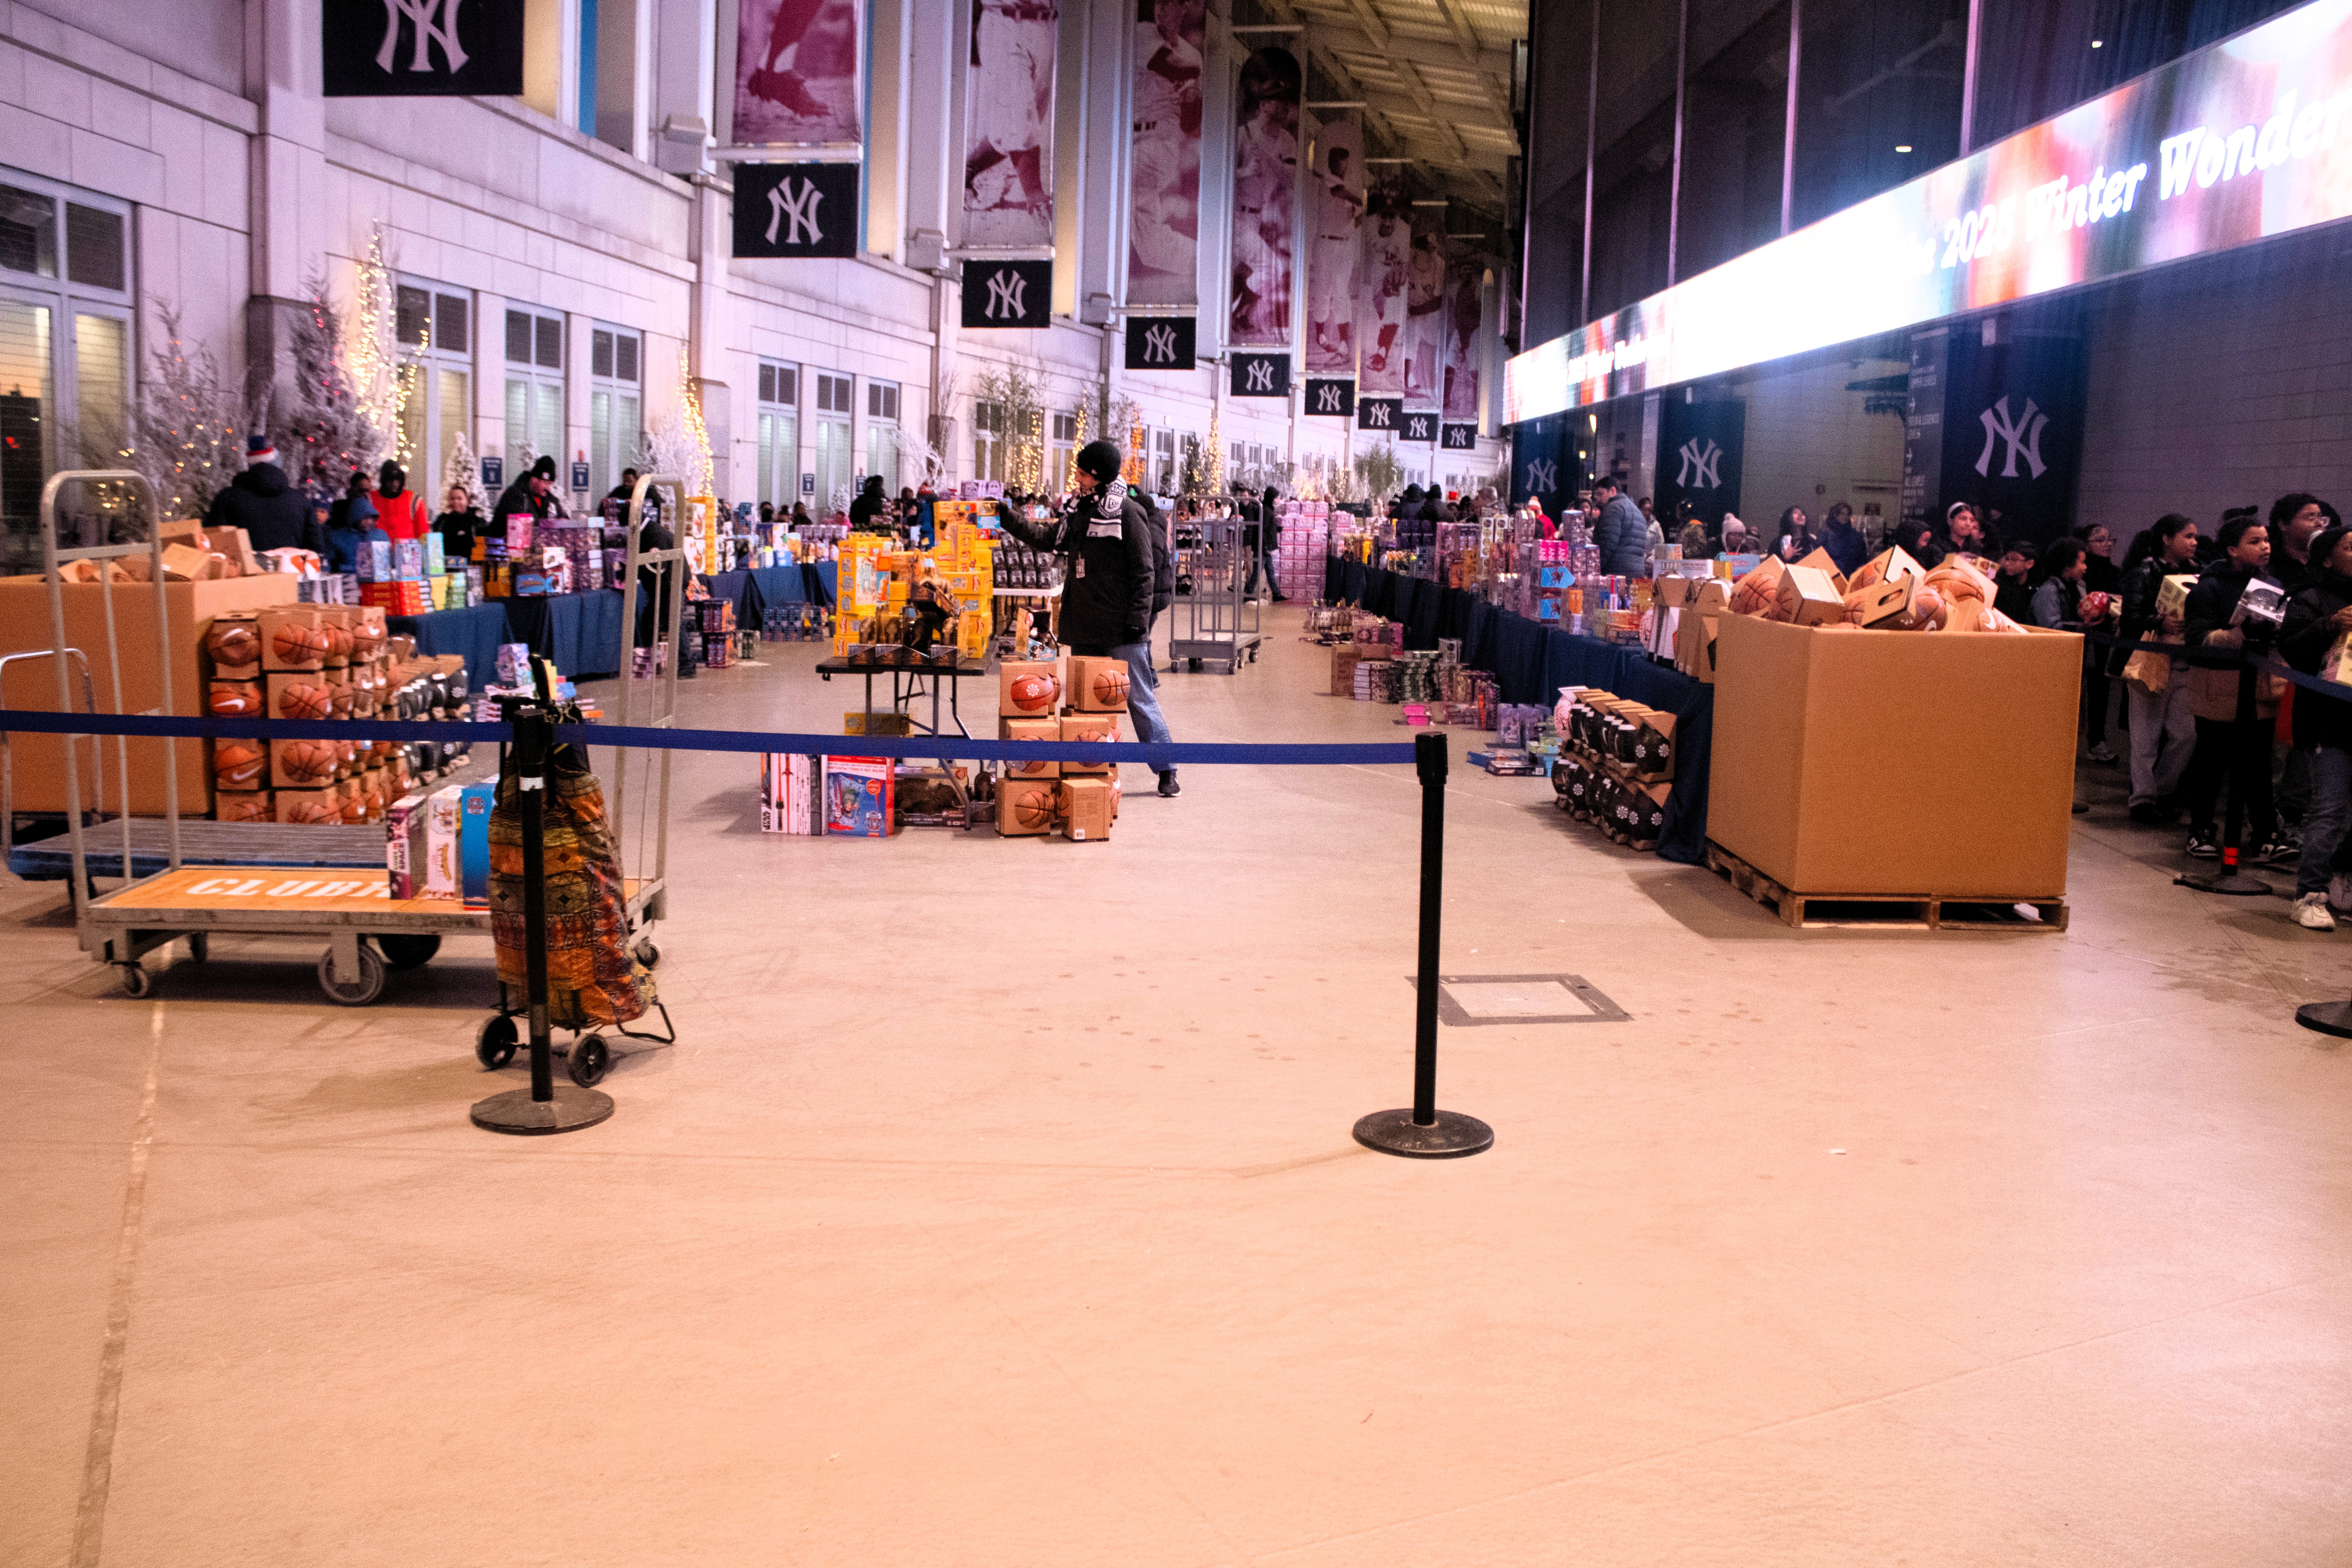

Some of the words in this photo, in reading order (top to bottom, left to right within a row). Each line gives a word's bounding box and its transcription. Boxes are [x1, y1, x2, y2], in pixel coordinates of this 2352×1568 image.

[765, 176, 824, 245] NY
[1941, 194, 2017, 269] 2025
[2025, 162, 2149, 242] Winter
[985, 270, 1027, 319] NY
[1144, 324, 1177, 362] NY
[1246, 359, 1274, 391] NY
[1318, 384, 1341, 411] NY
[1370, 403, 1391, 426] NY
[1409, 417, 1427, 438] NY
[1975, 395, 2050, 479] NY
[1526, 457, 1557, 493] NY
[1676, 437, 1723, 489] NY
